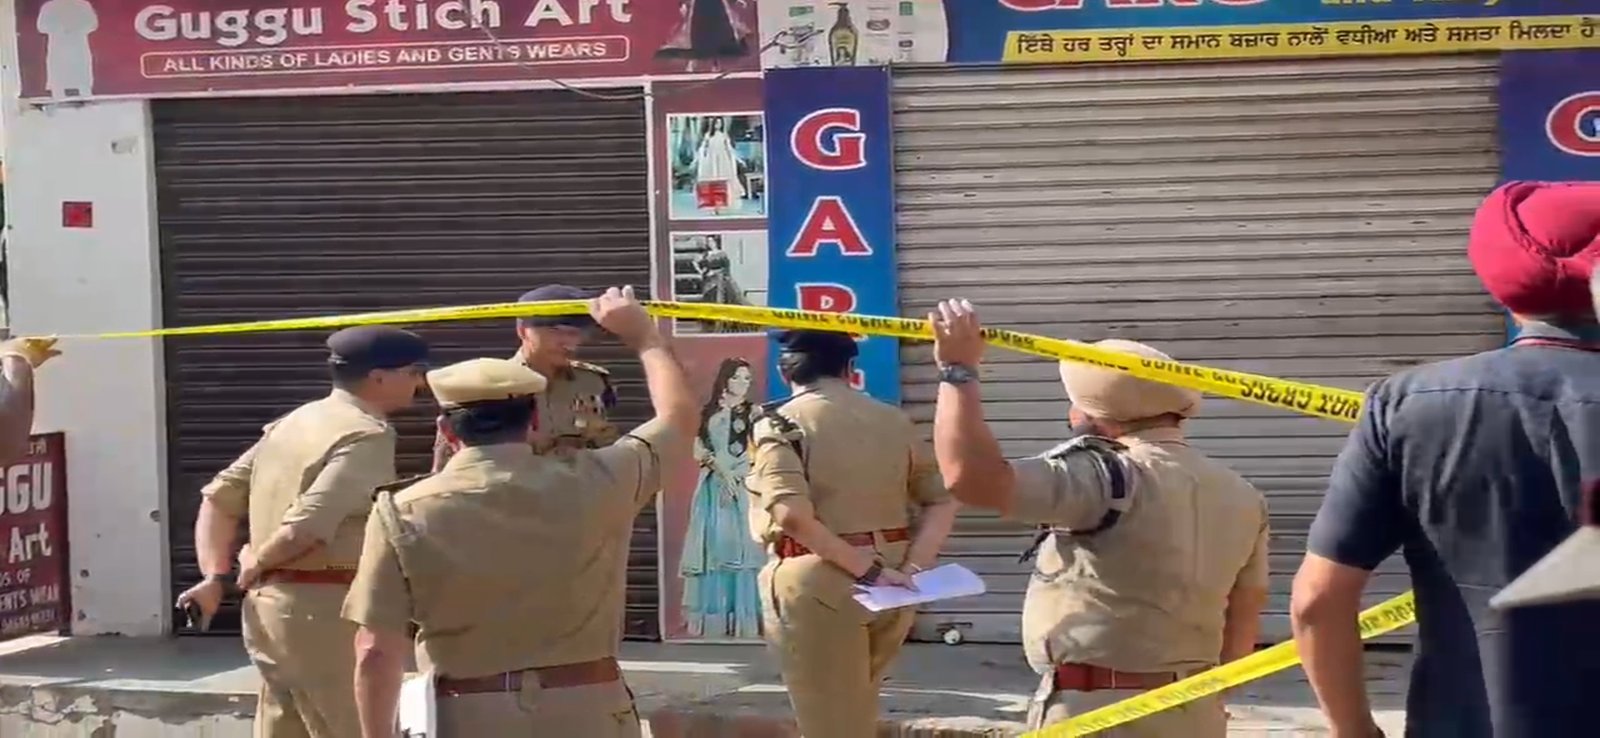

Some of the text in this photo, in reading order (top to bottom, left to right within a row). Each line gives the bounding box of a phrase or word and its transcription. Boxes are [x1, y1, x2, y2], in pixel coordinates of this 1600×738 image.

[134, 0, 633, 47] Guggu Stich Art
[1062, 37, 1092, 52] ਹਰ
[1141, 35, 1163, 50] ਦਾ
[1170, 34, 1222, 50] ਸਮਾਨ
[1335, 24, 1398, 45] ਵਧੀਆ
[1404, 22, 1440, 43] ਅਤੇ
[1445, 26, 1501, 42] ਸਸਤਾ
[1508, 20, 1571, 41] ਮਿਲਦਾ
[163, 42, 606, 72] ALL KINDS OF LADIES AND GENTS WEARS
[8, 522, 52, 563] Art
